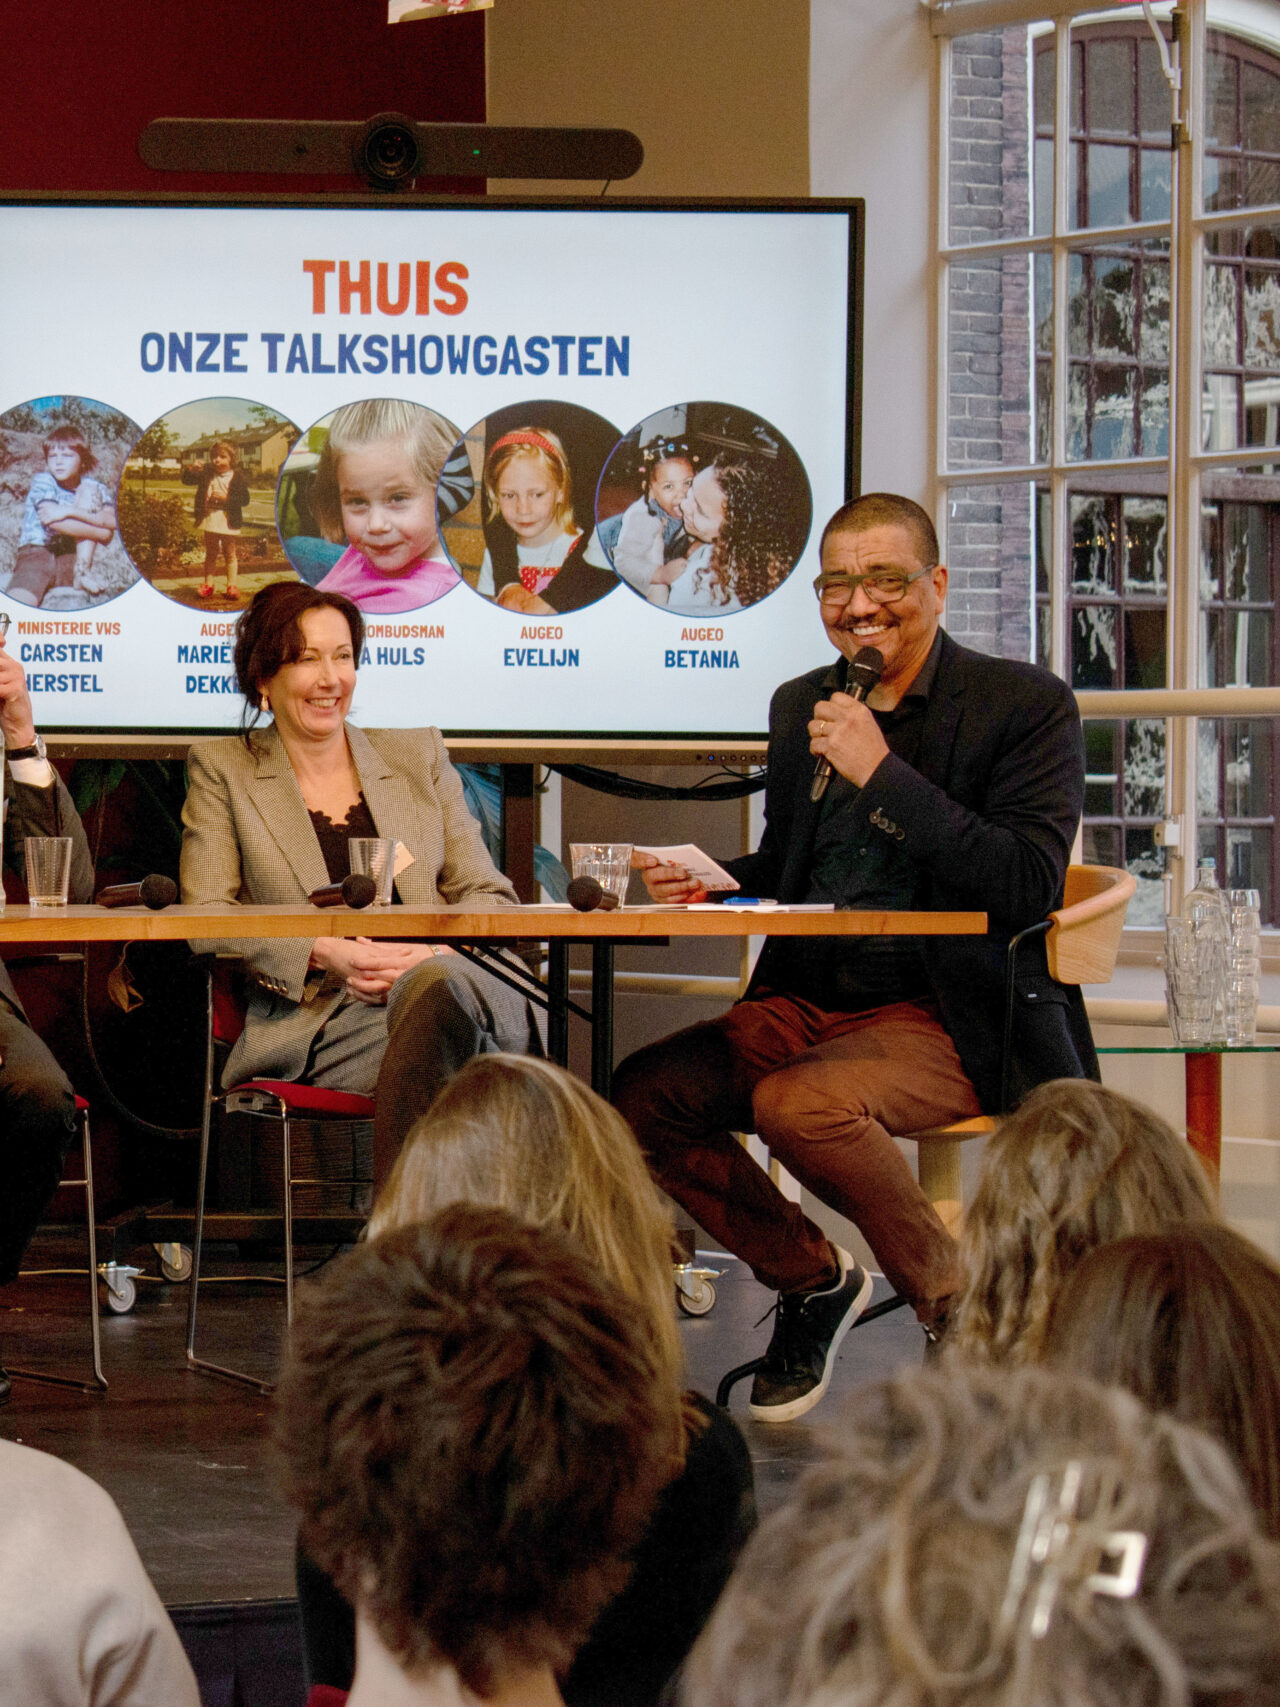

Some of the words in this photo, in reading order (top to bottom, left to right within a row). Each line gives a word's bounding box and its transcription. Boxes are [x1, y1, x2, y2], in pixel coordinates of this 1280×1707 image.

[302, 259, 470, 317] THUIS
[140, 332, 249, 374] ONZE
[261, 334, 630, 377] TALKSHOWGASTEN
[17, 621, 93, 635] MINISTERIE
[96, 622, 121, 636] VWS
[200, 622, 239, 637] AUGE
[520, 625, 563, 640] AUGEO
[681, 627, 724, 641] AUGEO
[20, 643, 104, 663] CARSTEN
[177, 641, 235, 664] MARIË
[376, 646, 426, 666] HULS
[504, 648, 580, 668] EVELIJN
[664, 650, 740, 669] BETANIA
